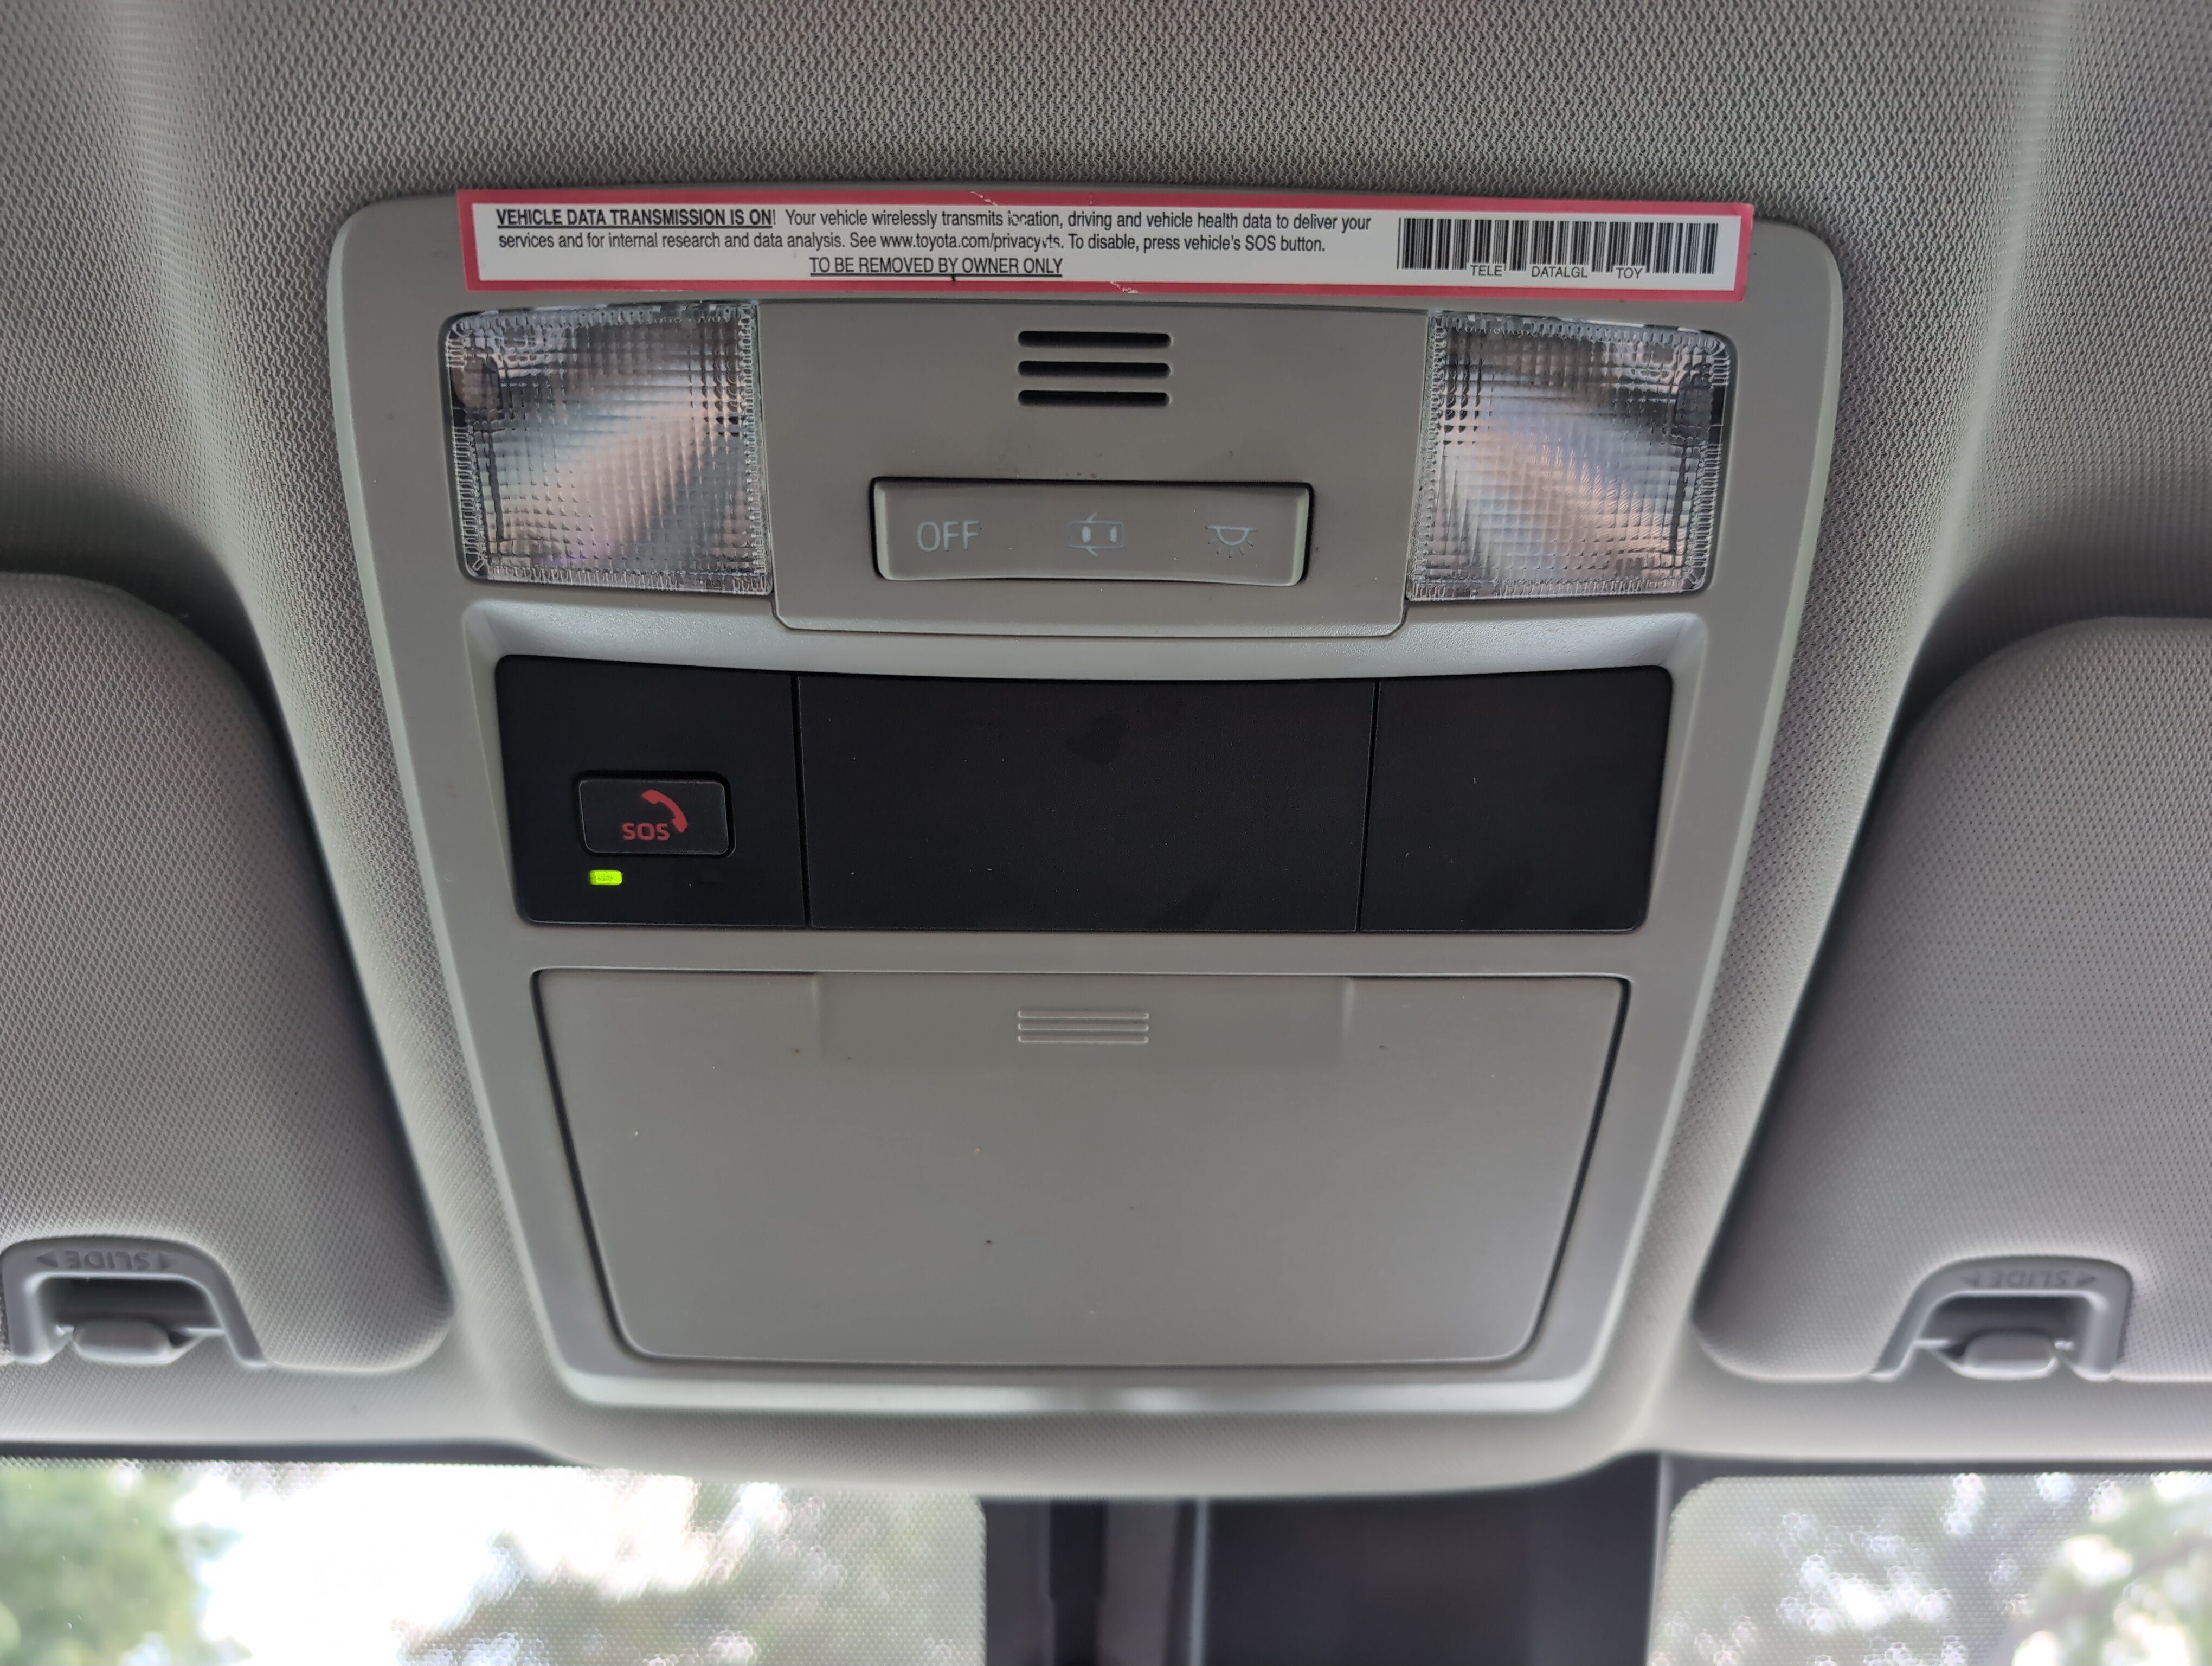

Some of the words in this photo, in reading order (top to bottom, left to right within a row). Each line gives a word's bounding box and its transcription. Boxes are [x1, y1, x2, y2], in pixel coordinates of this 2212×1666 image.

[496, 209, 562, 225] VEHICLE
[567, 209, 607, 225] DATA
[610, 209, 725, 225] TRANSMISSION
[730, 209, 745, 225] IS
[749, 209, 776, 225] ON!
[785, 209, 816, 225] Your
[820, 209, 867, 226] vehicle
[872, 209, 938, 229] wirelessly
[942, 210, 1004, 226] transmits
[1068, 211, 1111, 230] driving
[1117, 211, 1142, 227] and
[1146, 212, 1193, 228] vehicle
[1198, 212, 1238, 228] health
[1243, 213, 1272, 229] data
[1276, 214, 1289, 229] to
[1294, 214, 1338, 229] deliver
[1341, 217, 1372, 234] your
[499, 232, 554, 248] services
[558, 232, 583, 248] and
[587, 232, 605, 248] for
[608, 232, 658, 248] internal
[663, 232, 720, 248] research
[725, 232, 749, 248] and
[754, 232, 783, 248] data
[787, 232, 845, 252] analysis.
[850, 232, 876, 248] See
[1068, 233, 1084, 249] To
[1088, 233, 1139, 252] disable,
[1143, 237, 1180, 254] press
[1184, 234, 1241, 251] vehicle's
[1245, 234, 1276, 251] SOS
[1281, 235, 1326, 252] button.
[809, 257, 831, 272] TO
[835, 257, 855, 272] BE
[859, 257, 934, 273] REMOVED
[938, 257, 959, 273] BY
[962, 257, 1019, 273] OWNER
[1024, 258, 1063, 274] ONLY
[1470, 265, 1503, 277] TELE
[1531, 266, 1588, 278] DATALGL
[1615, 267, 1643, 279] TOY
[916, 521, 980, 553] OFF
[622, 822, 671, 841] SOS
[64, 1250, 150, 1270] SLIDE
